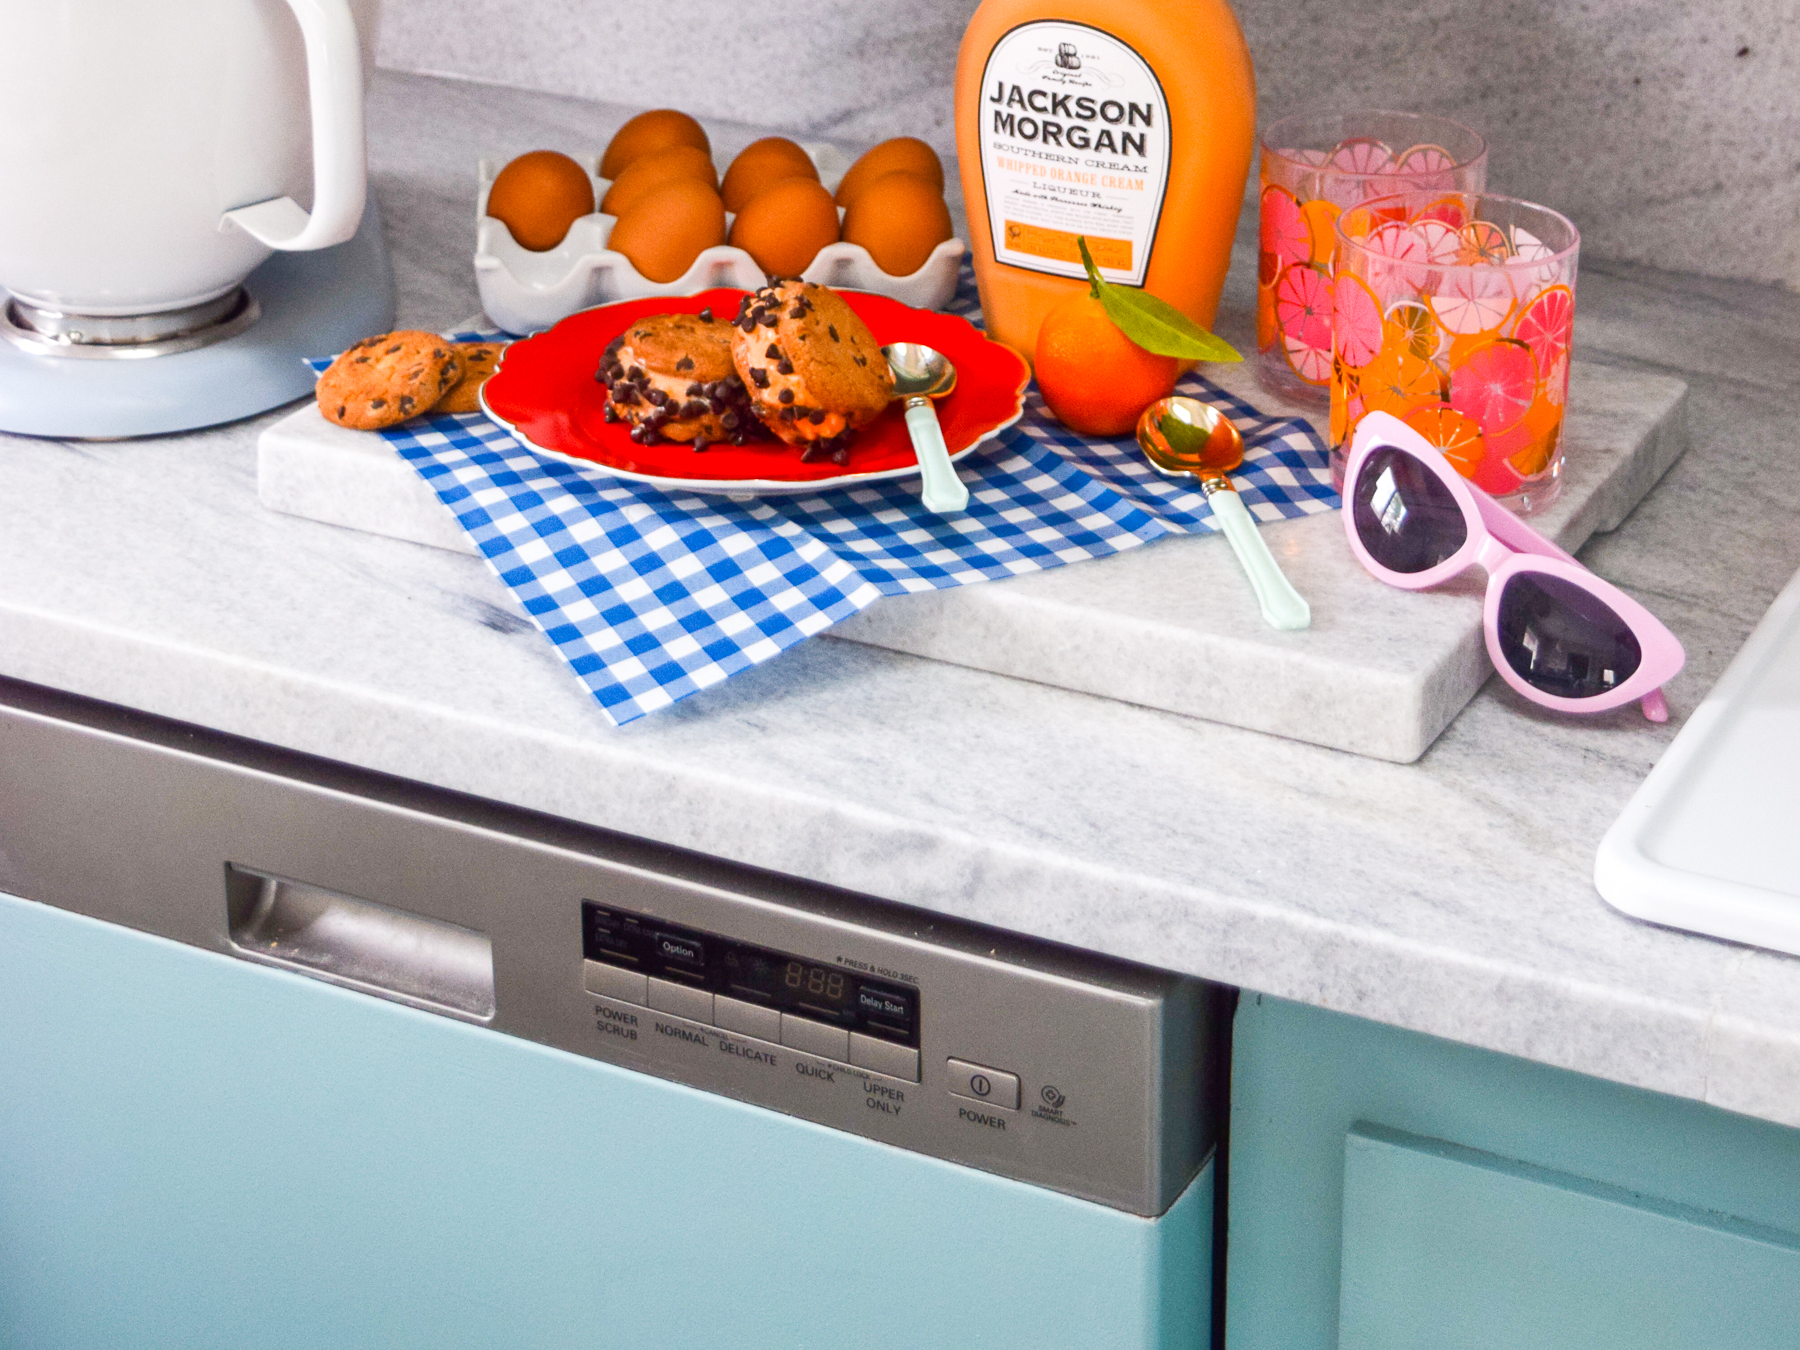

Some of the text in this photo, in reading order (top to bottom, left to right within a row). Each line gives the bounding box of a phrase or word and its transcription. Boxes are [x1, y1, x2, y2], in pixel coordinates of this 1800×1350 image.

[989, 80, 1153, 128] JACKSON
[993, 109, 1147, 159] MORGAN
[993, 141, 1149, 173] SOUTHERN CREAM
[996, 155, 1145, 192] WHIPPED ORANGE CREAM
[1032, 181, 1103, 199] LIQUEUR
[662, 940, 694, 958] Option
[844, 957, 869, 970] PRESS
[877, 967, 899, 979] HOLD
[860, 993, 904, 1014] Delay Start
[594, 1005, 639, 1028] POWER
[596, 1019, 638, 1041] SCRUB
[654, 1021, 709, 1048] NORMAL
[719, 1040, 777, 1066] DELICATE
[795, 1062, 835, 1083] QUICK
[863, 1081, 905, 1102] UPPER
[866, 1097, 902, 1116] ONLY
[1038, 1105, 1063, 1117] SMART
[958, 1107, 1006, 1131] POWER
